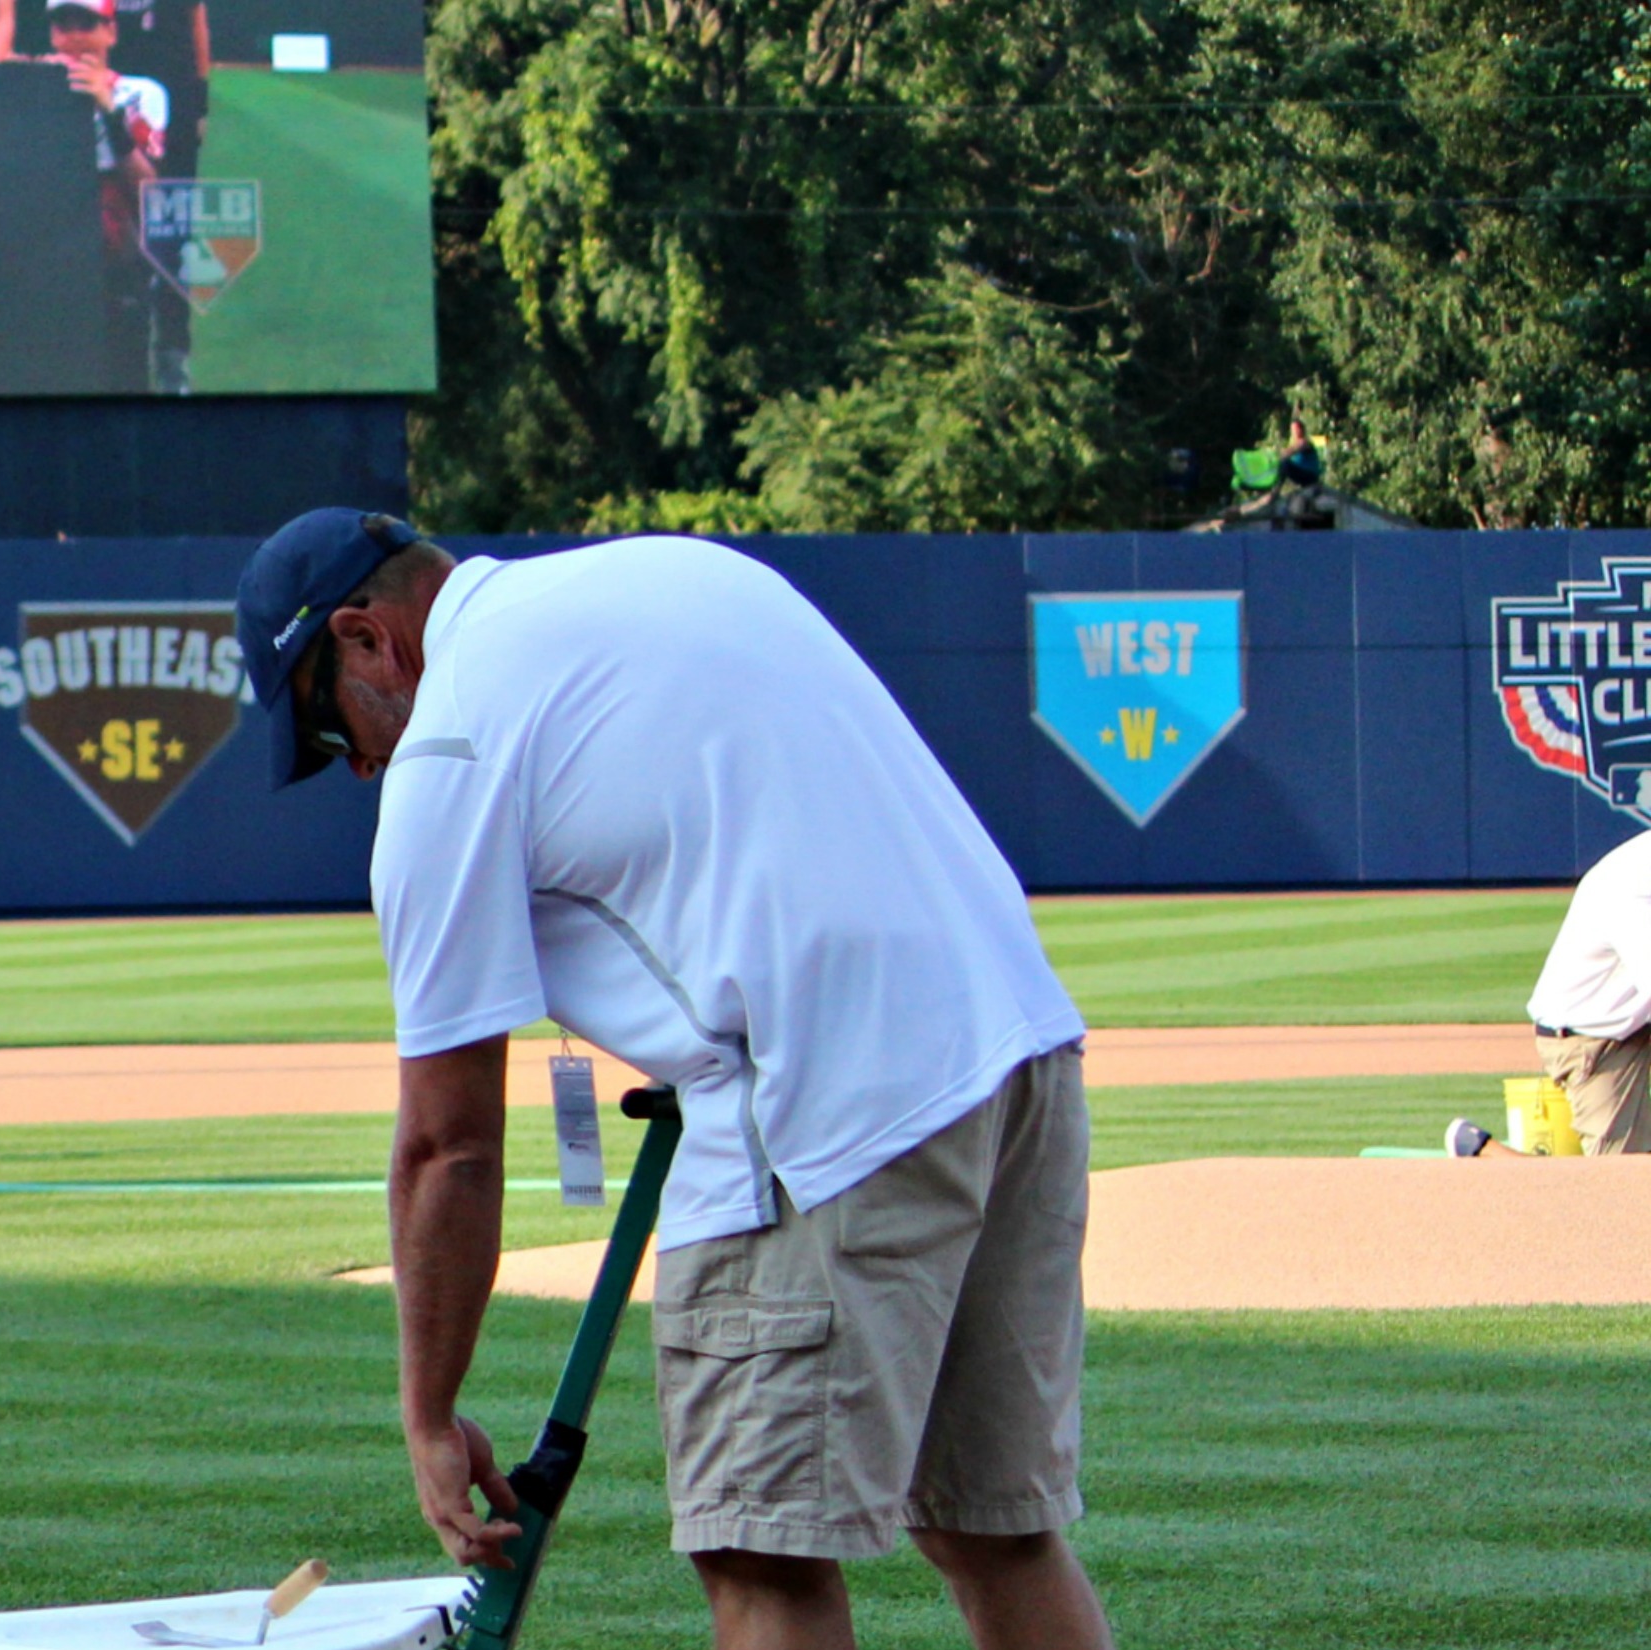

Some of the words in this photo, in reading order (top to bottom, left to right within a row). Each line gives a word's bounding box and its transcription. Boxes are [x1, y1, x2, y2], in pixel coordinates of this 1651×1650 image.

[1075, 620, 1200, 678] WEST
[1509, 617, 1651, 669] LITTLE
[101, 718, 162, 781] SE
[1118, 708, 1157, 761] W
